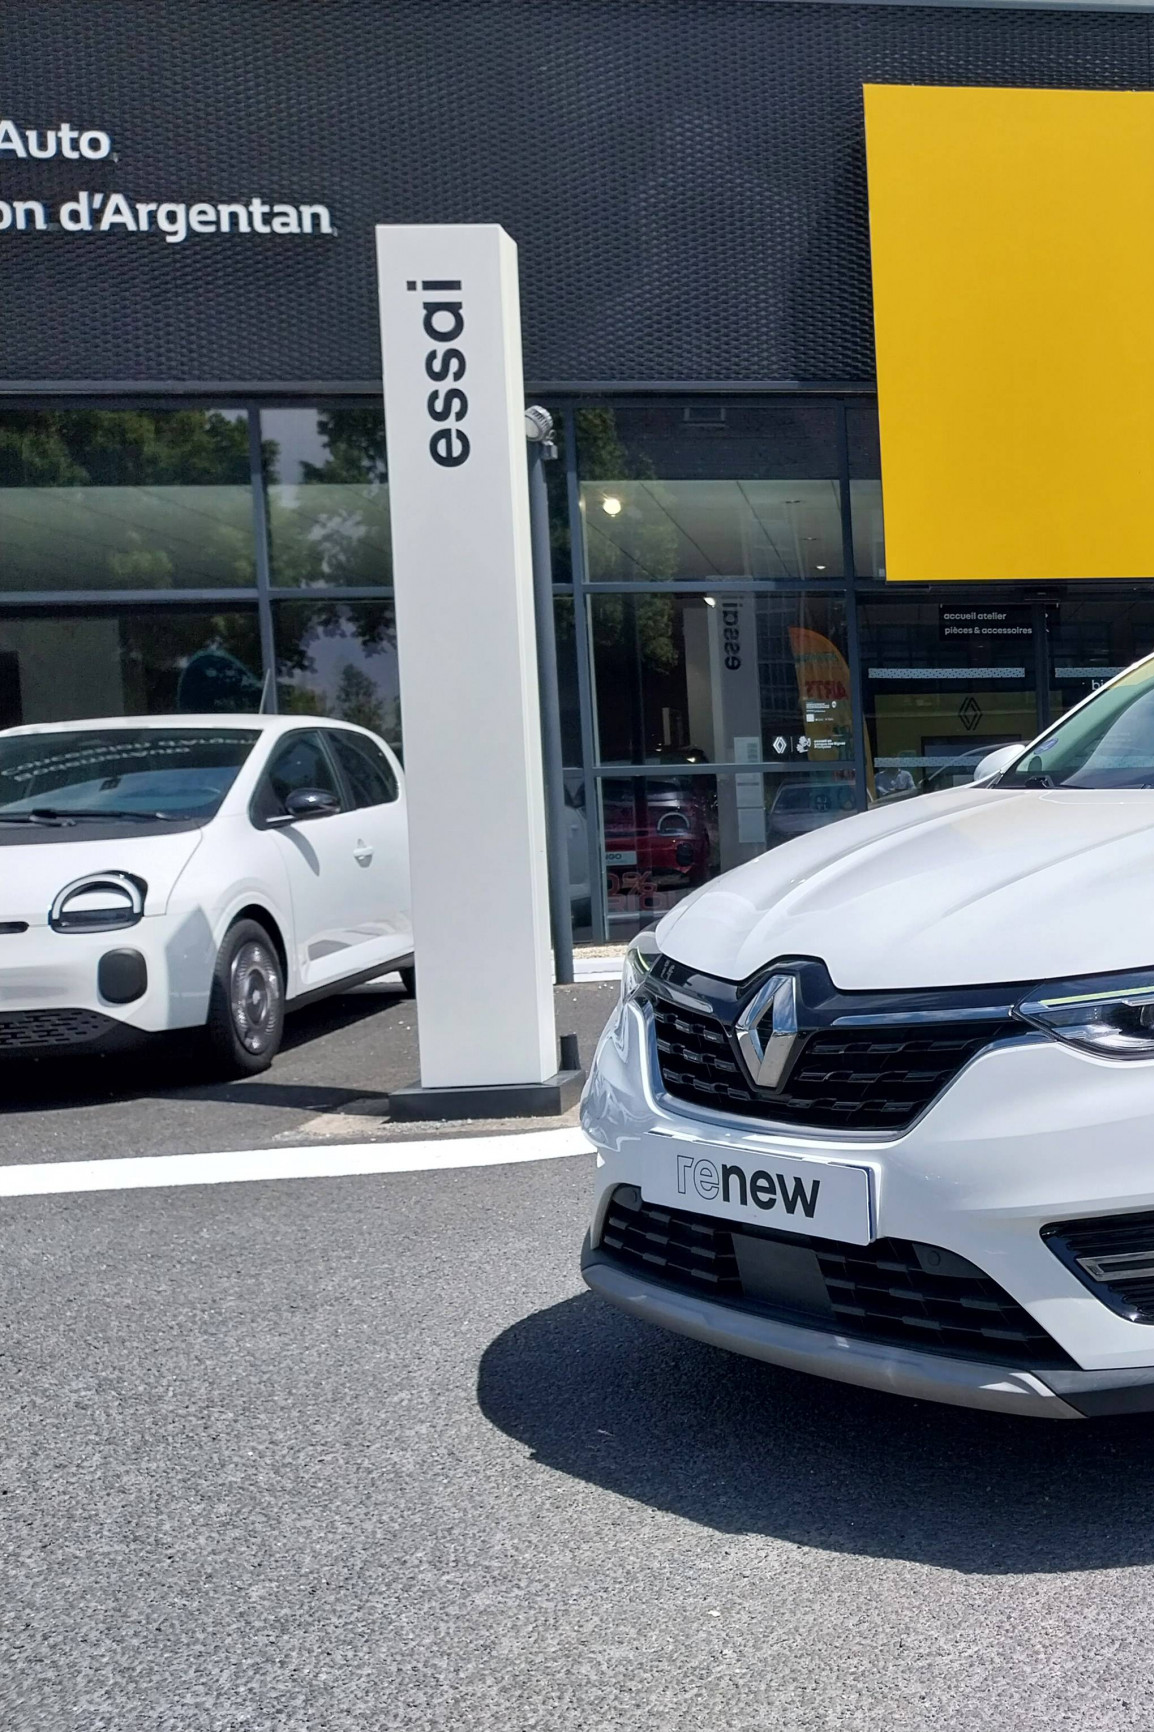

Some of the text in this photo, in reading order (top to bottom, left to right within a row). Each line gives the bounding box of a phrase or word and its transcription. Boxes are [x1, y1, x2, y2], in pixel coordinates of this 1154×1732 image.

[0, 119, 111, 159] Auto
[59, 190, 333, 243] d'Argentan
[405, 279, 471, 469] essai
[943, 612, 1007, 621] accueil atelier
[944, 626, 973, 635] pièces
[981, 626, 1033, 635] accessoires
[676, 1154, 821, 1219] renew
